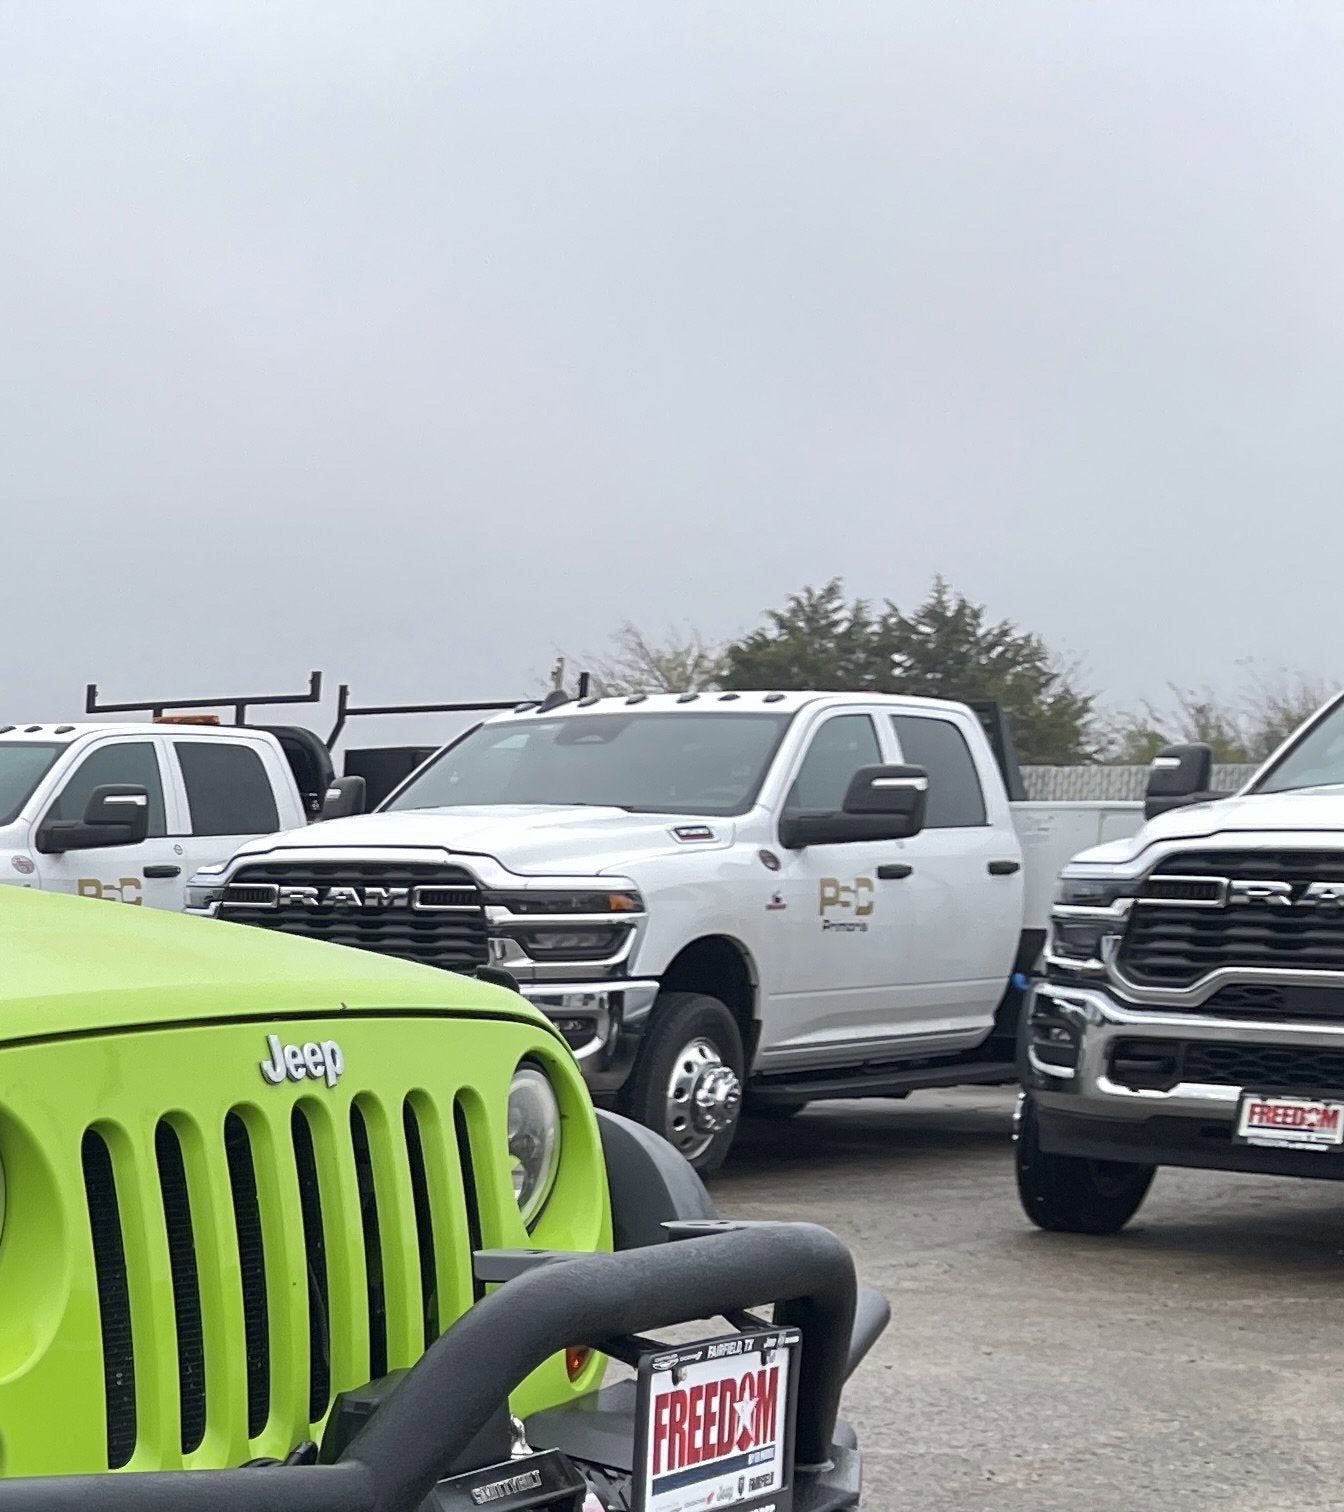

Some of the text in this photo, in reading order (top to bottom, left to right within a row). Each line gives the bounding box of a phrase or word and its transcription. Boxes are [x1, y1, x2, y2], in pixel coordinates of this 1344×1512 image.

[279, 886, 409, 907] RAM
[260, 1034, 345, 1089] Jeep
[1248, 1103, 1340, 1130] FREEDOM
[653, 1366, 779, 1476] FREEDOM
